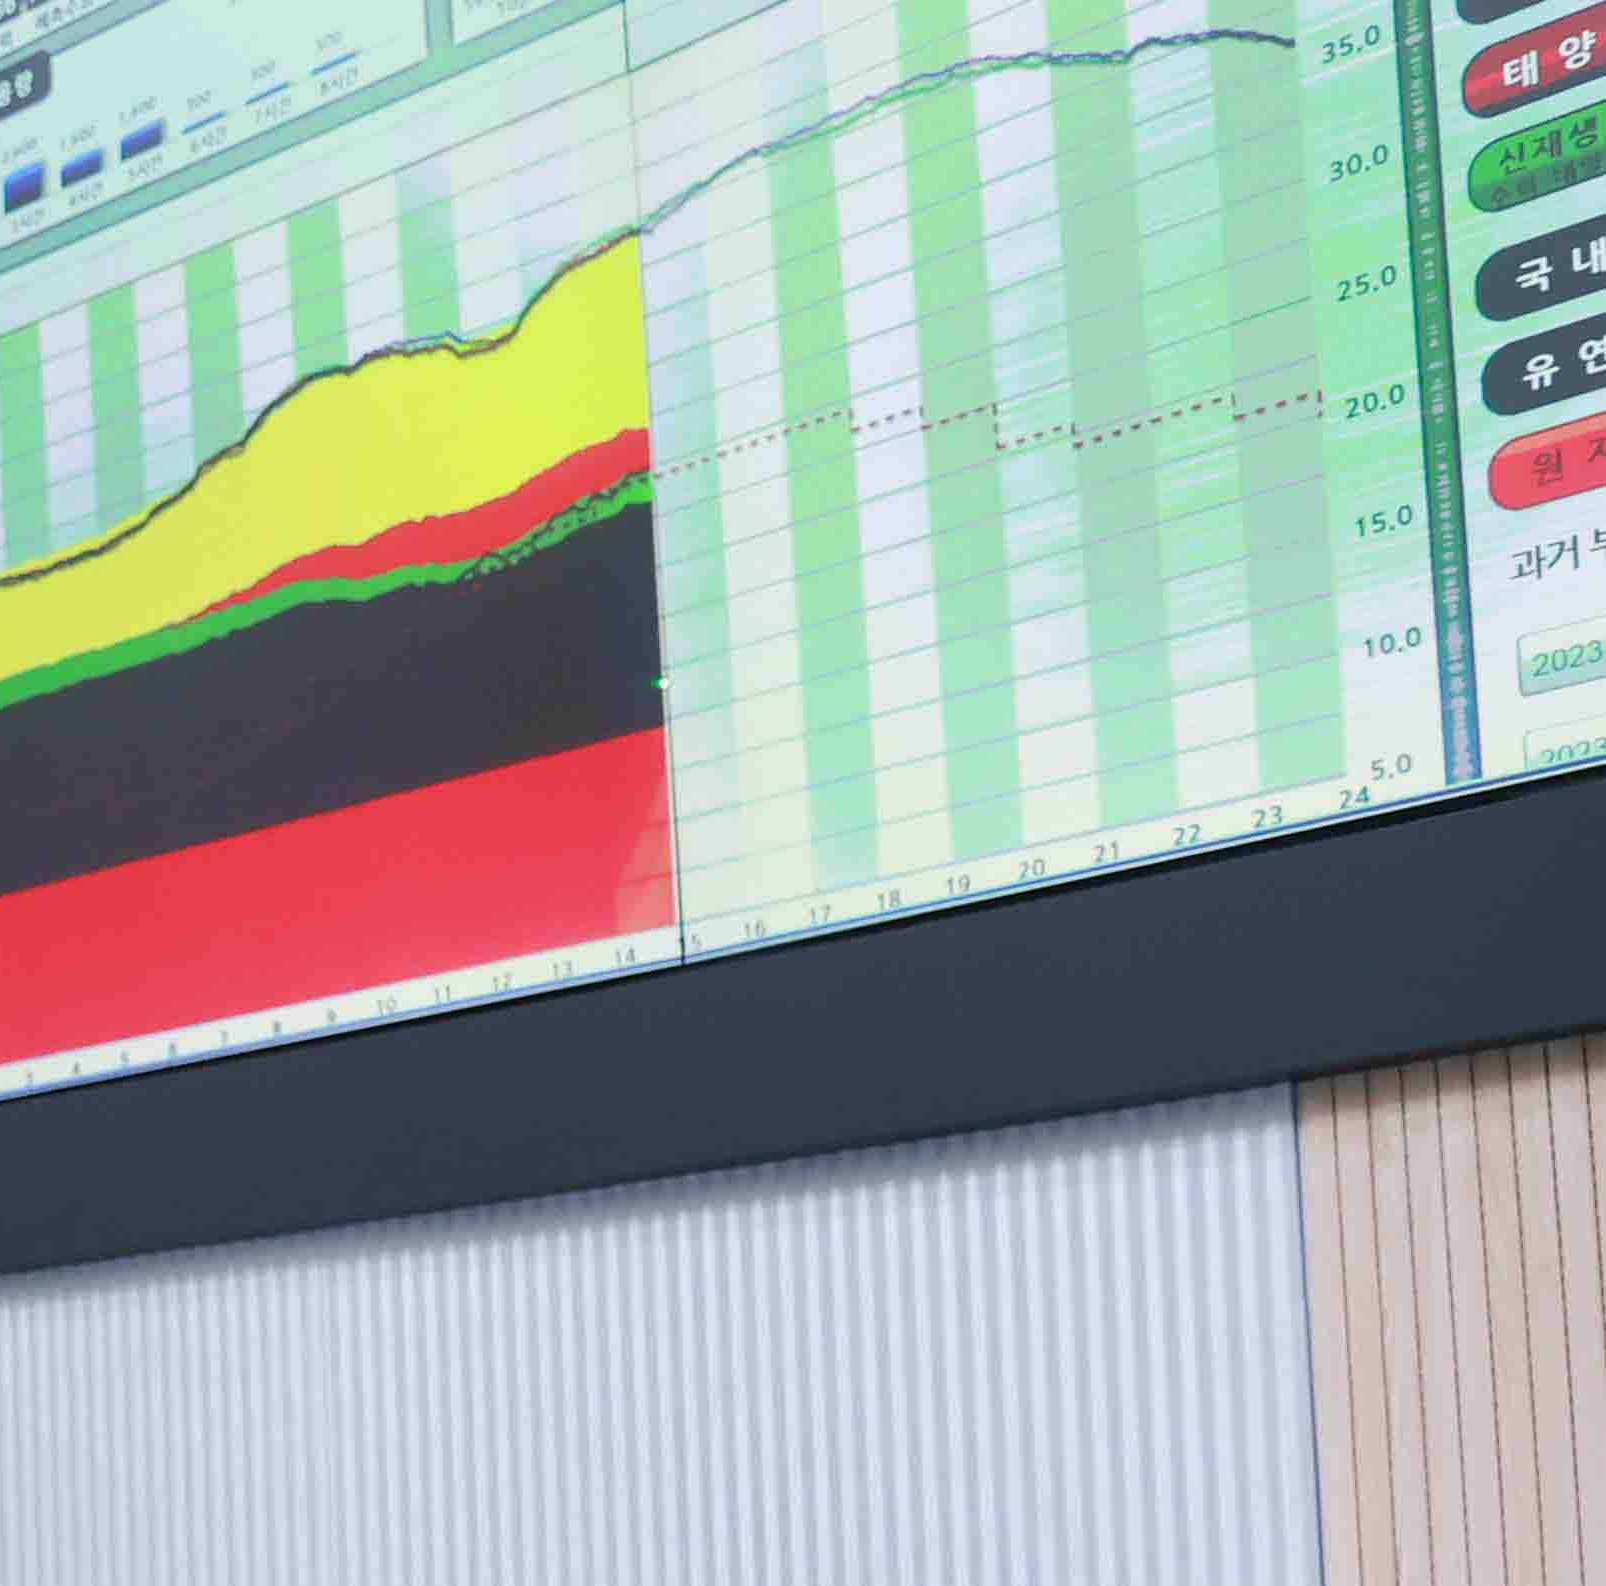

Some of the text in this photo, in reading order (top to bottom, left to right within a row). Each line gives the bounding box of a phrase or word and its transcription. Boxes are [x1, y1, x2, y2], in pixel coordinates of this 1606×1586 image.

[1322, 24, 1380, 65] 35.0
[1330, 144, 1389, 183] 30.0
[1337, 265, 1396, 302] 25.0
[1346, 383, 1405, 419] 20.0
[1355, 504, 1413, 537] 15.0
[1510, 534, 1580, 580] 과거
[1364, 626, 1422, 657] 10.0
[1532, 639, 1604, 677] 2023
[1370, 753, 1412, 781] 5.0
[1018, 858, 1045, 880] 20
[1093, 840, 1119, 862] 21
[1173, 823, 1201, 846] 22
[1253, 806, 1283, 829] 23
[1339, 785, 1369, 810] 24
